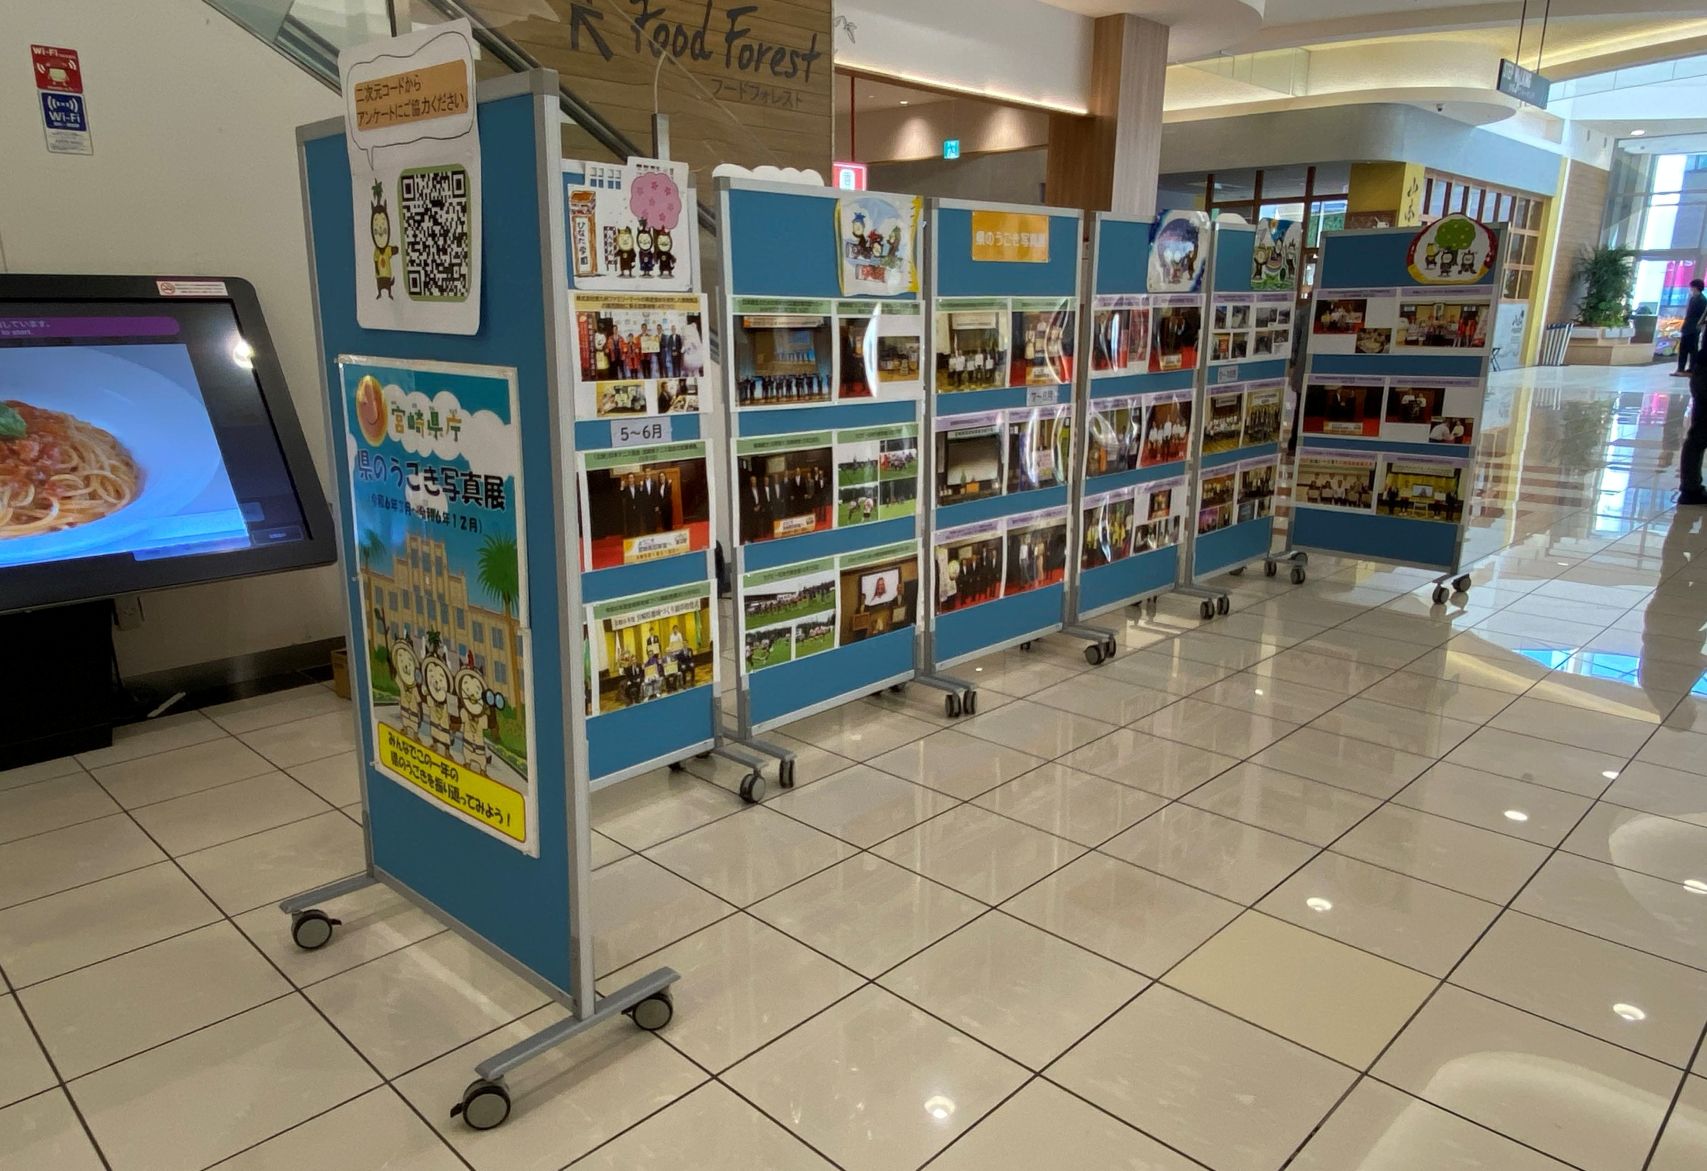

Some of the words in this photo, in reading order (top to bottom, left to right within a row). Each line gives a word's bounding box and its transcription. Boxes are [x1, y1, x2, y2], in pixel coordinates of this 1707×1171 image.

[630, 0, 713, 61] Food
[725, 5, 822, 83] Forest
[356, 75, 422, 103] 二次元コードから
[711, 78, 802, 108] フードフォレスト
[48, 111, 81, 123] Wi-Fi
[356, 93, 464, 126] アンケートにご協力ください
[391, 405, 463, 442] 宮崎県庁
[620, 423, 662, 442] 5～6月
[357, 449, 506, 511] 県のうごき写真展
[388, 731, 459, 783] みんなでこの一年の
[391, 751, 512, 828] 県のうごきを振り返ってみよう！
